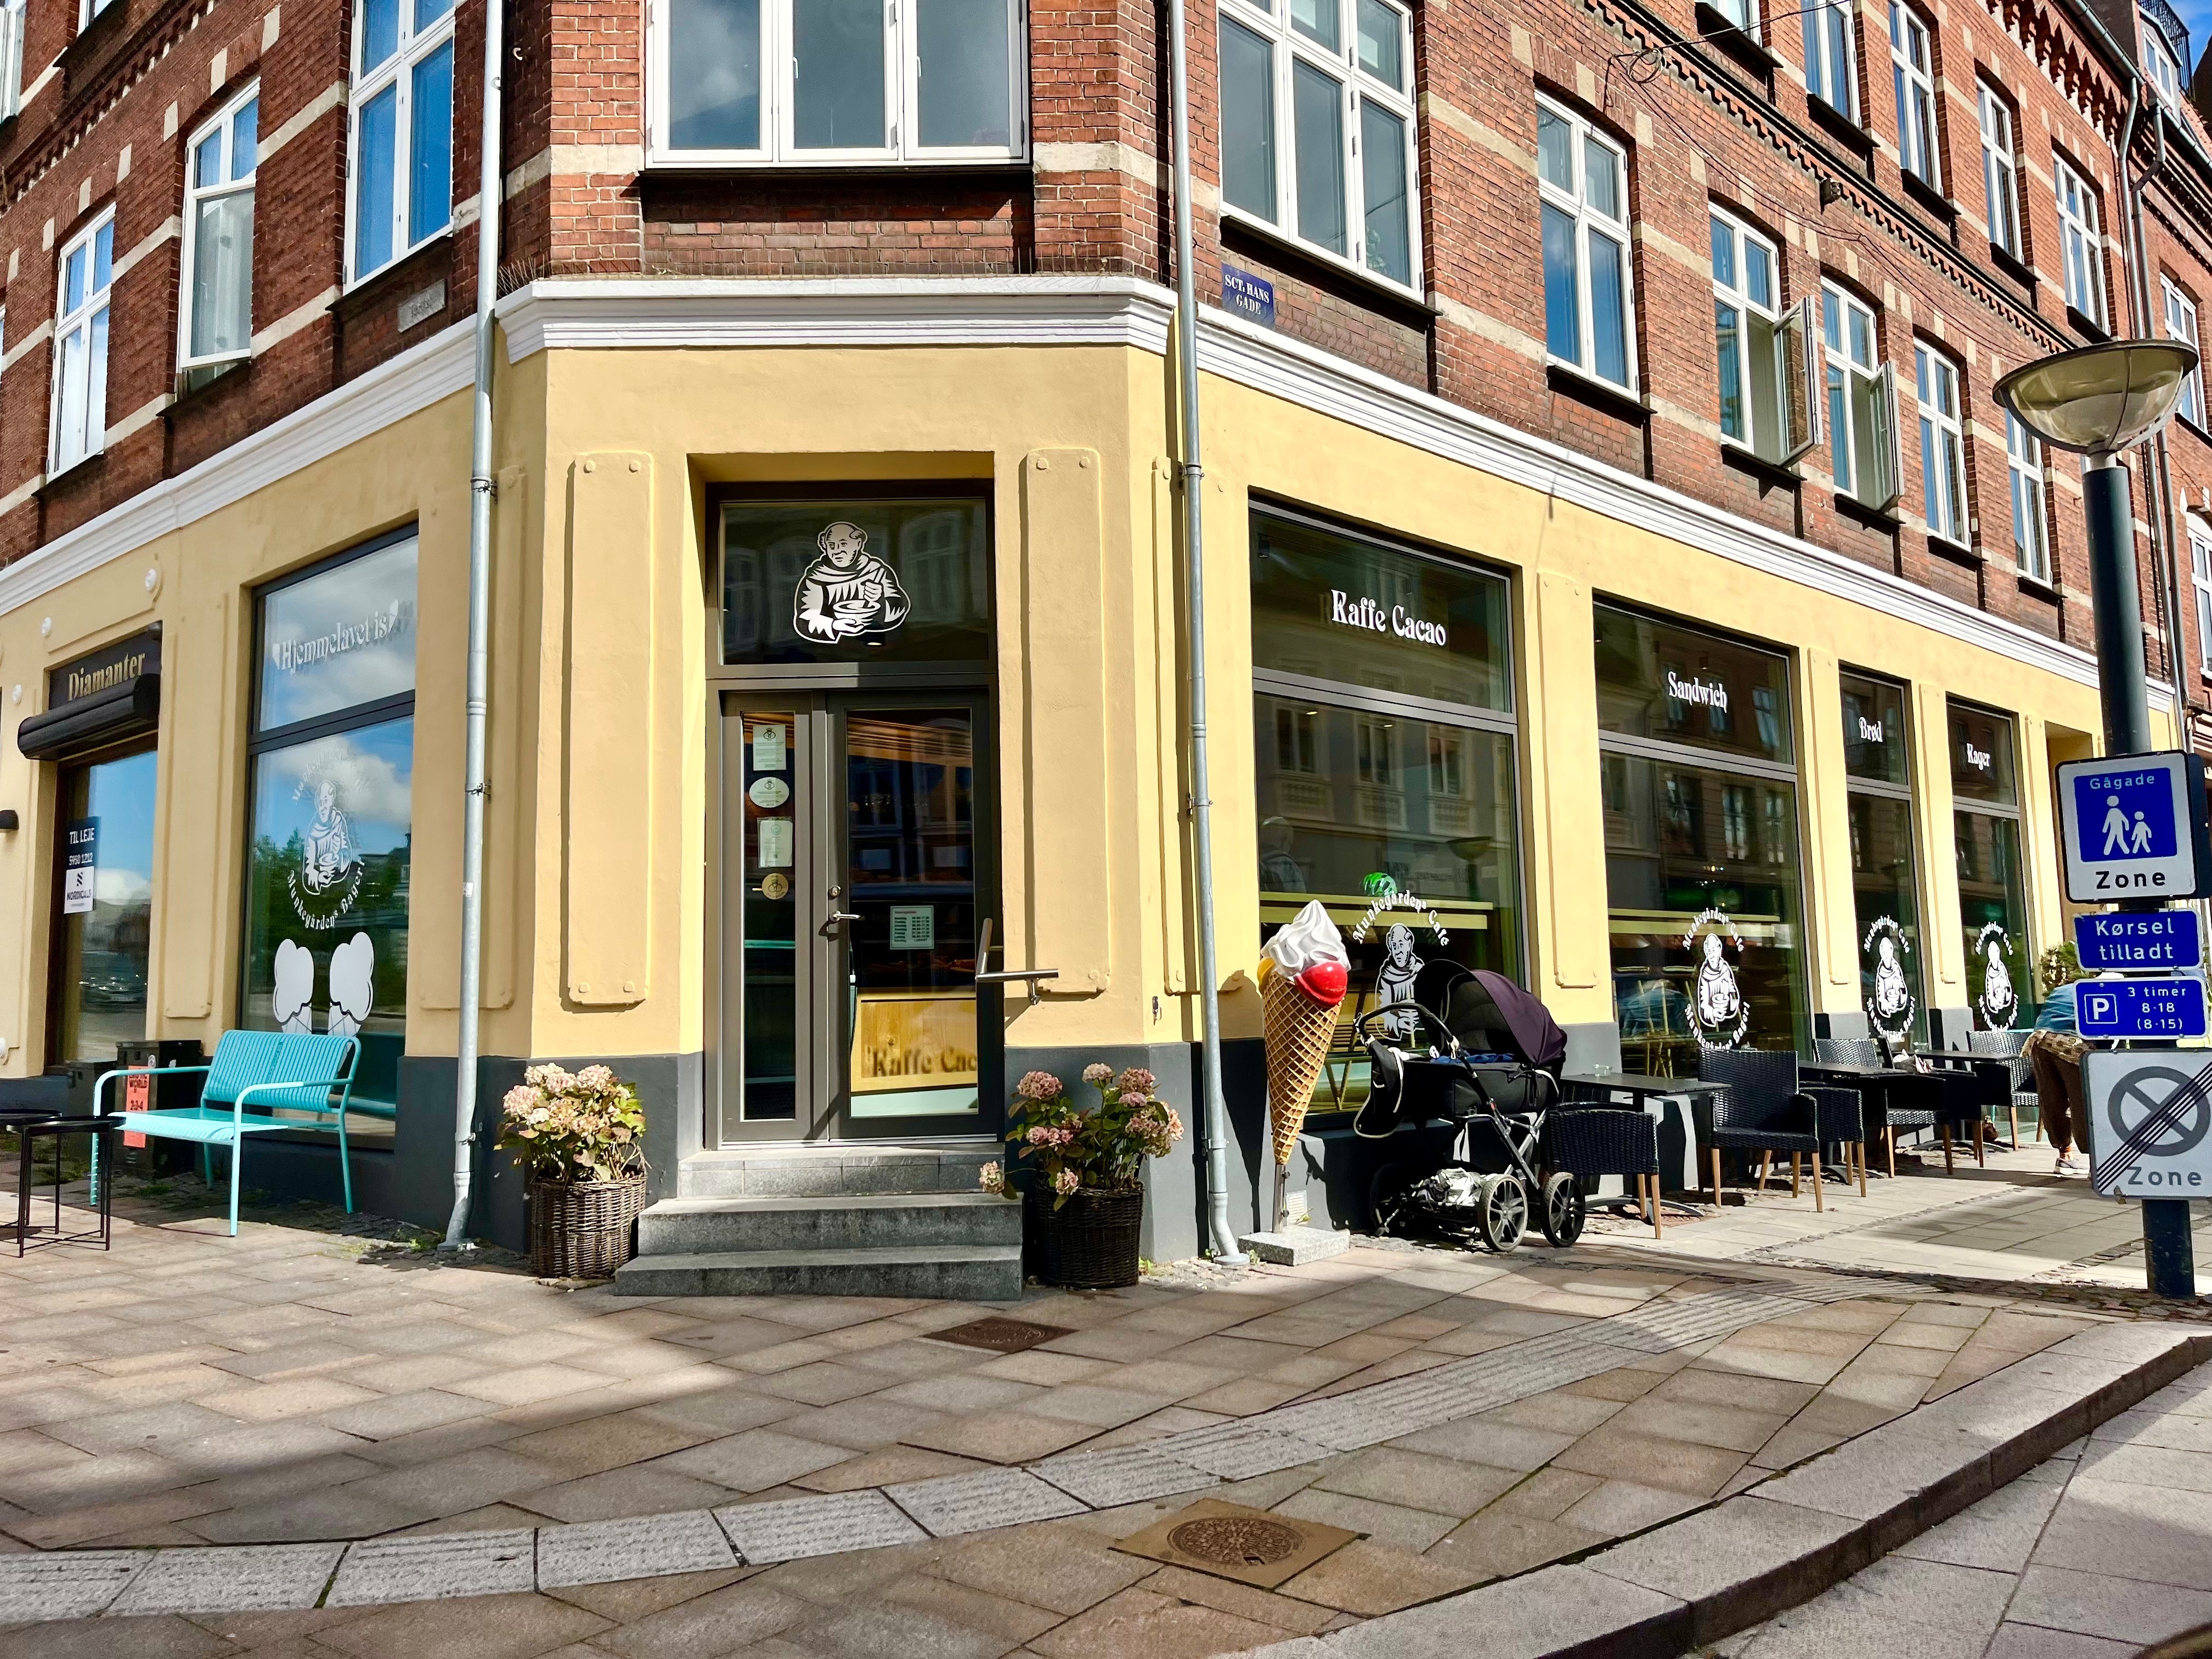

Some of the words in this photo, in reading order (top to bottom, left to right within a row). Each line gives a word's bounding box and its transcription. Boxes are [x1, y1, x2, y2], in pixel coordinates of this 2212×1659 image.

[1246, 283, 1269, 303] HANS
[1236, 294, 1261, 315] GADE
[1331, 589, 1386, 631] Kaffe
[1392, 605, 1446, 646] Cacao
[281, 615, 370, 675] Hjemmelavet
[374, 611, 387, 640] is
[68, 653, 145, 701] Diamanter
[1668, 671, 1728, 713] Sandwich
[1859, 716, 1883, 742] Brød
[1966, 743, 1990, 770] Kager
[2090, 773, 2155, 789] Gågade
[69, 831, 79, 844] TIL
[80, 827, 95, 843] LEJE
[2096, 871, 2165, 889] Zone
[2095, 918, 2174, 936] Kørsel
[2099, 943, 2174, 960] tilladt
[2128, 987, 2135, 997] 3
[2144, 986, 2186, 997] timer
[2092, 997, 2109, 1020] P
[2126, 1166, 2202, 1186] Zone
